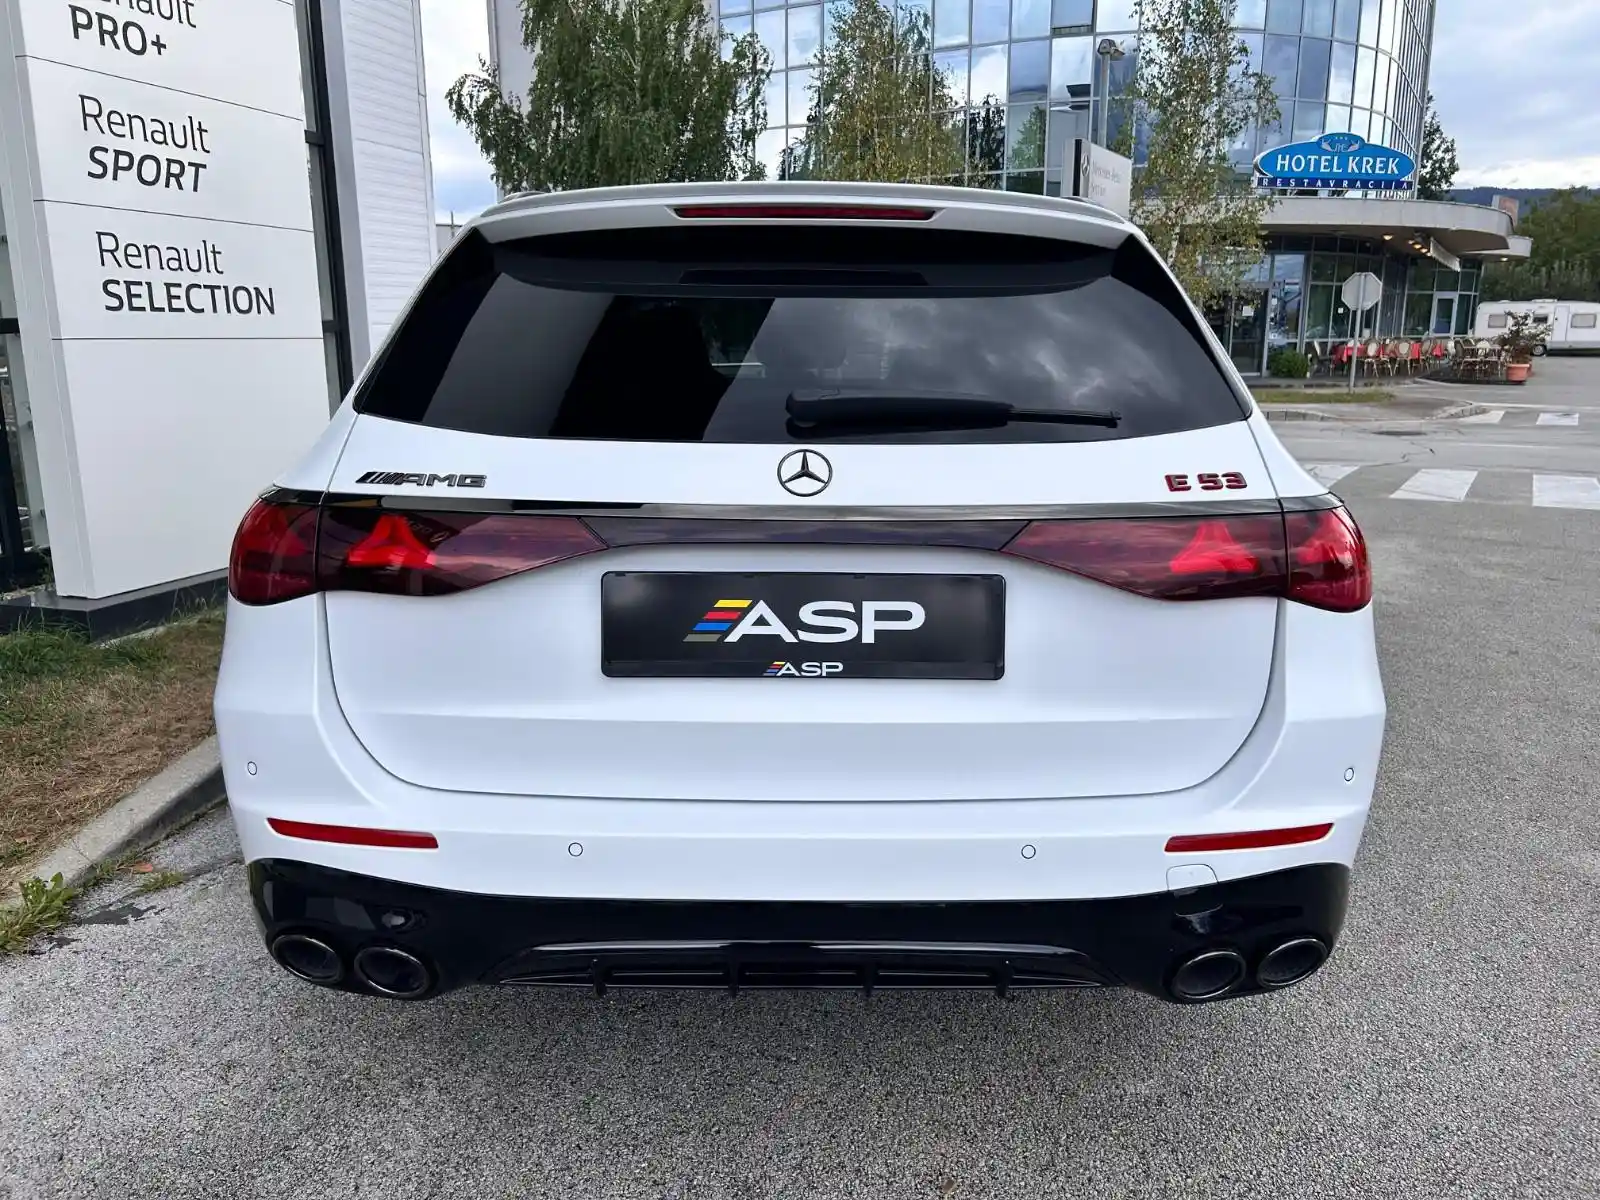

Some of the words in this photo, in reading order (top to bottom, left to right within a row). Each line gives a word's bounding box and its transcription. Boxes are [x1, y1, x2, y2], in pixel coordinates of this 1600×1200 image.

[68, 4, 167, 56] PRO+
[102, 0, 197, 28] ault
[78, 94, 211, 154] Renault
[87, 146, 207, 192] SPORT
[1276, 154, 1343, 173] HOTEL
[1347, 156, 1400, 175] KREK
[1262, 179, 1408, 189] RESTAVRACIJA
[96, 231, 224, 275] Renault
[102, 279, 275, 315] SELECTION
[1164, 474, 1192, 492] E
[1197, 471, 1248, 491] 53
[723, 599, 926, 643] ASP
[775, 661, 844, 677] ASP
